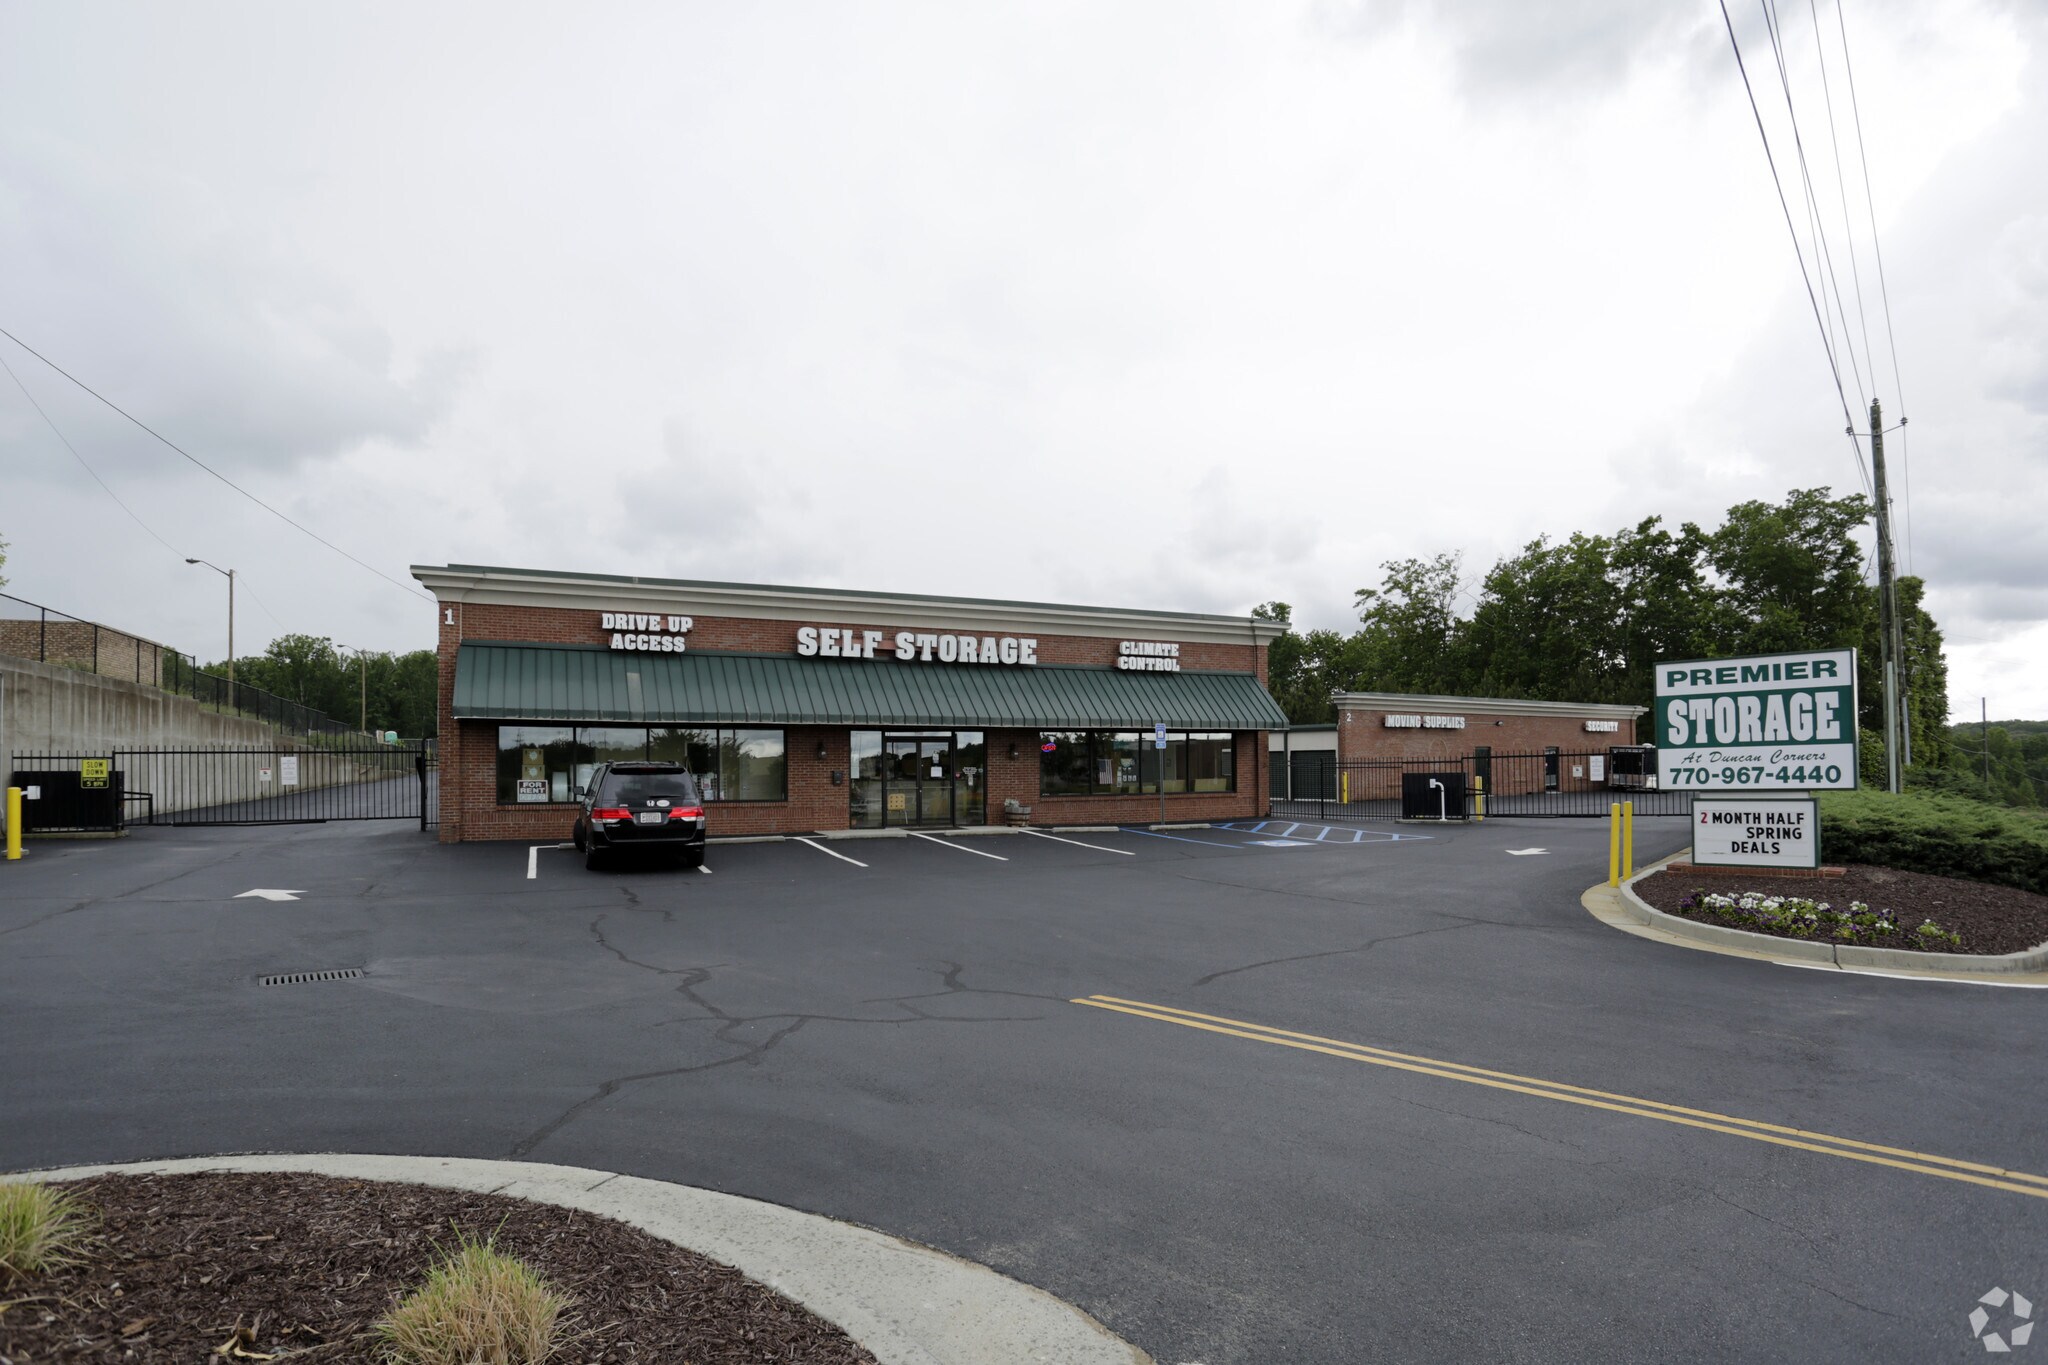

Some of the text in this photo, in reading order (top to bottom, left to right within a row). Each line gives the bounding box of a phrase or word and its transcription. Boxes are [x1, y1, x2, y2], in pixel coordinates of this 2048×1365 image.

[445, 608, 454, 625] 1
[602, 613, 693, 633] DRIVE UP
[610, 633, 686, 653] ACCESS
[797, 626, 1037, 665] SELF STORAGE
[1119, 641, 1179, 656] CLIMATE
[1118, 656, 1180, 671] CONTROL
[1667, 659, 1838, 688] PREMIER
[1385, 714, 1465, 729] MOVING SUPPLIES
[1585, 720, 1619, 732] SECURITY
[1667, 691, 1841, 745] STORAGE
[1681, 749, 1826, 765] At Duncan Corners
[1669, 764, 1842, 785] 770-967-4440
[1700, 812, 1805, 825] 2 MONTH HALF
[1746, 826, 1802, 840] SPRING
[1731, 841, 1780, 854] DEALS
